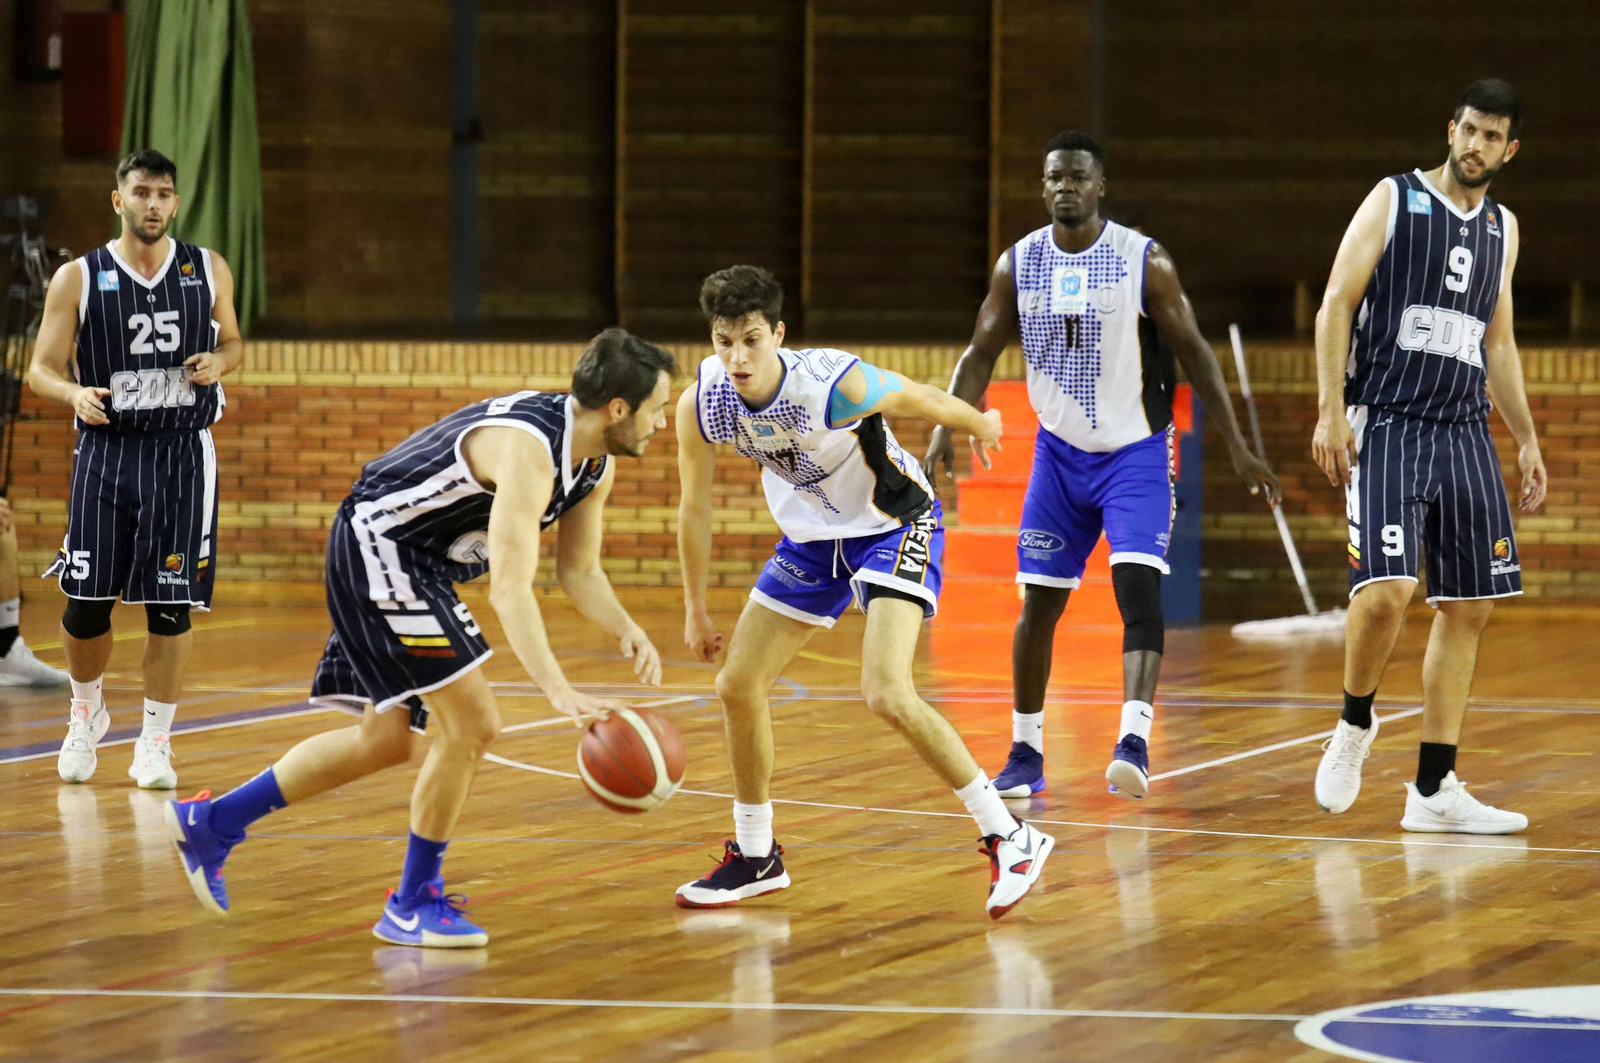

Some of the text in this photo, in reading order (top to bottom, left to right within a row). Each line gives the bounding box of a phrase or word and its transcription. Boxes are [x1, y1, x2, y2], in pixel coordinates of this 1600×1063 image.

[1445, 245, 1473, 293] 9
[128, 310, 181, 355] 25
[1064, 316, 1080, 349] 11
[1021, 532, 1053, 549] Ford
[1381, 524, 1405, 557] 9
[167, 576, 190, 586] Huelva
[452, 602, 481, 637] 5
